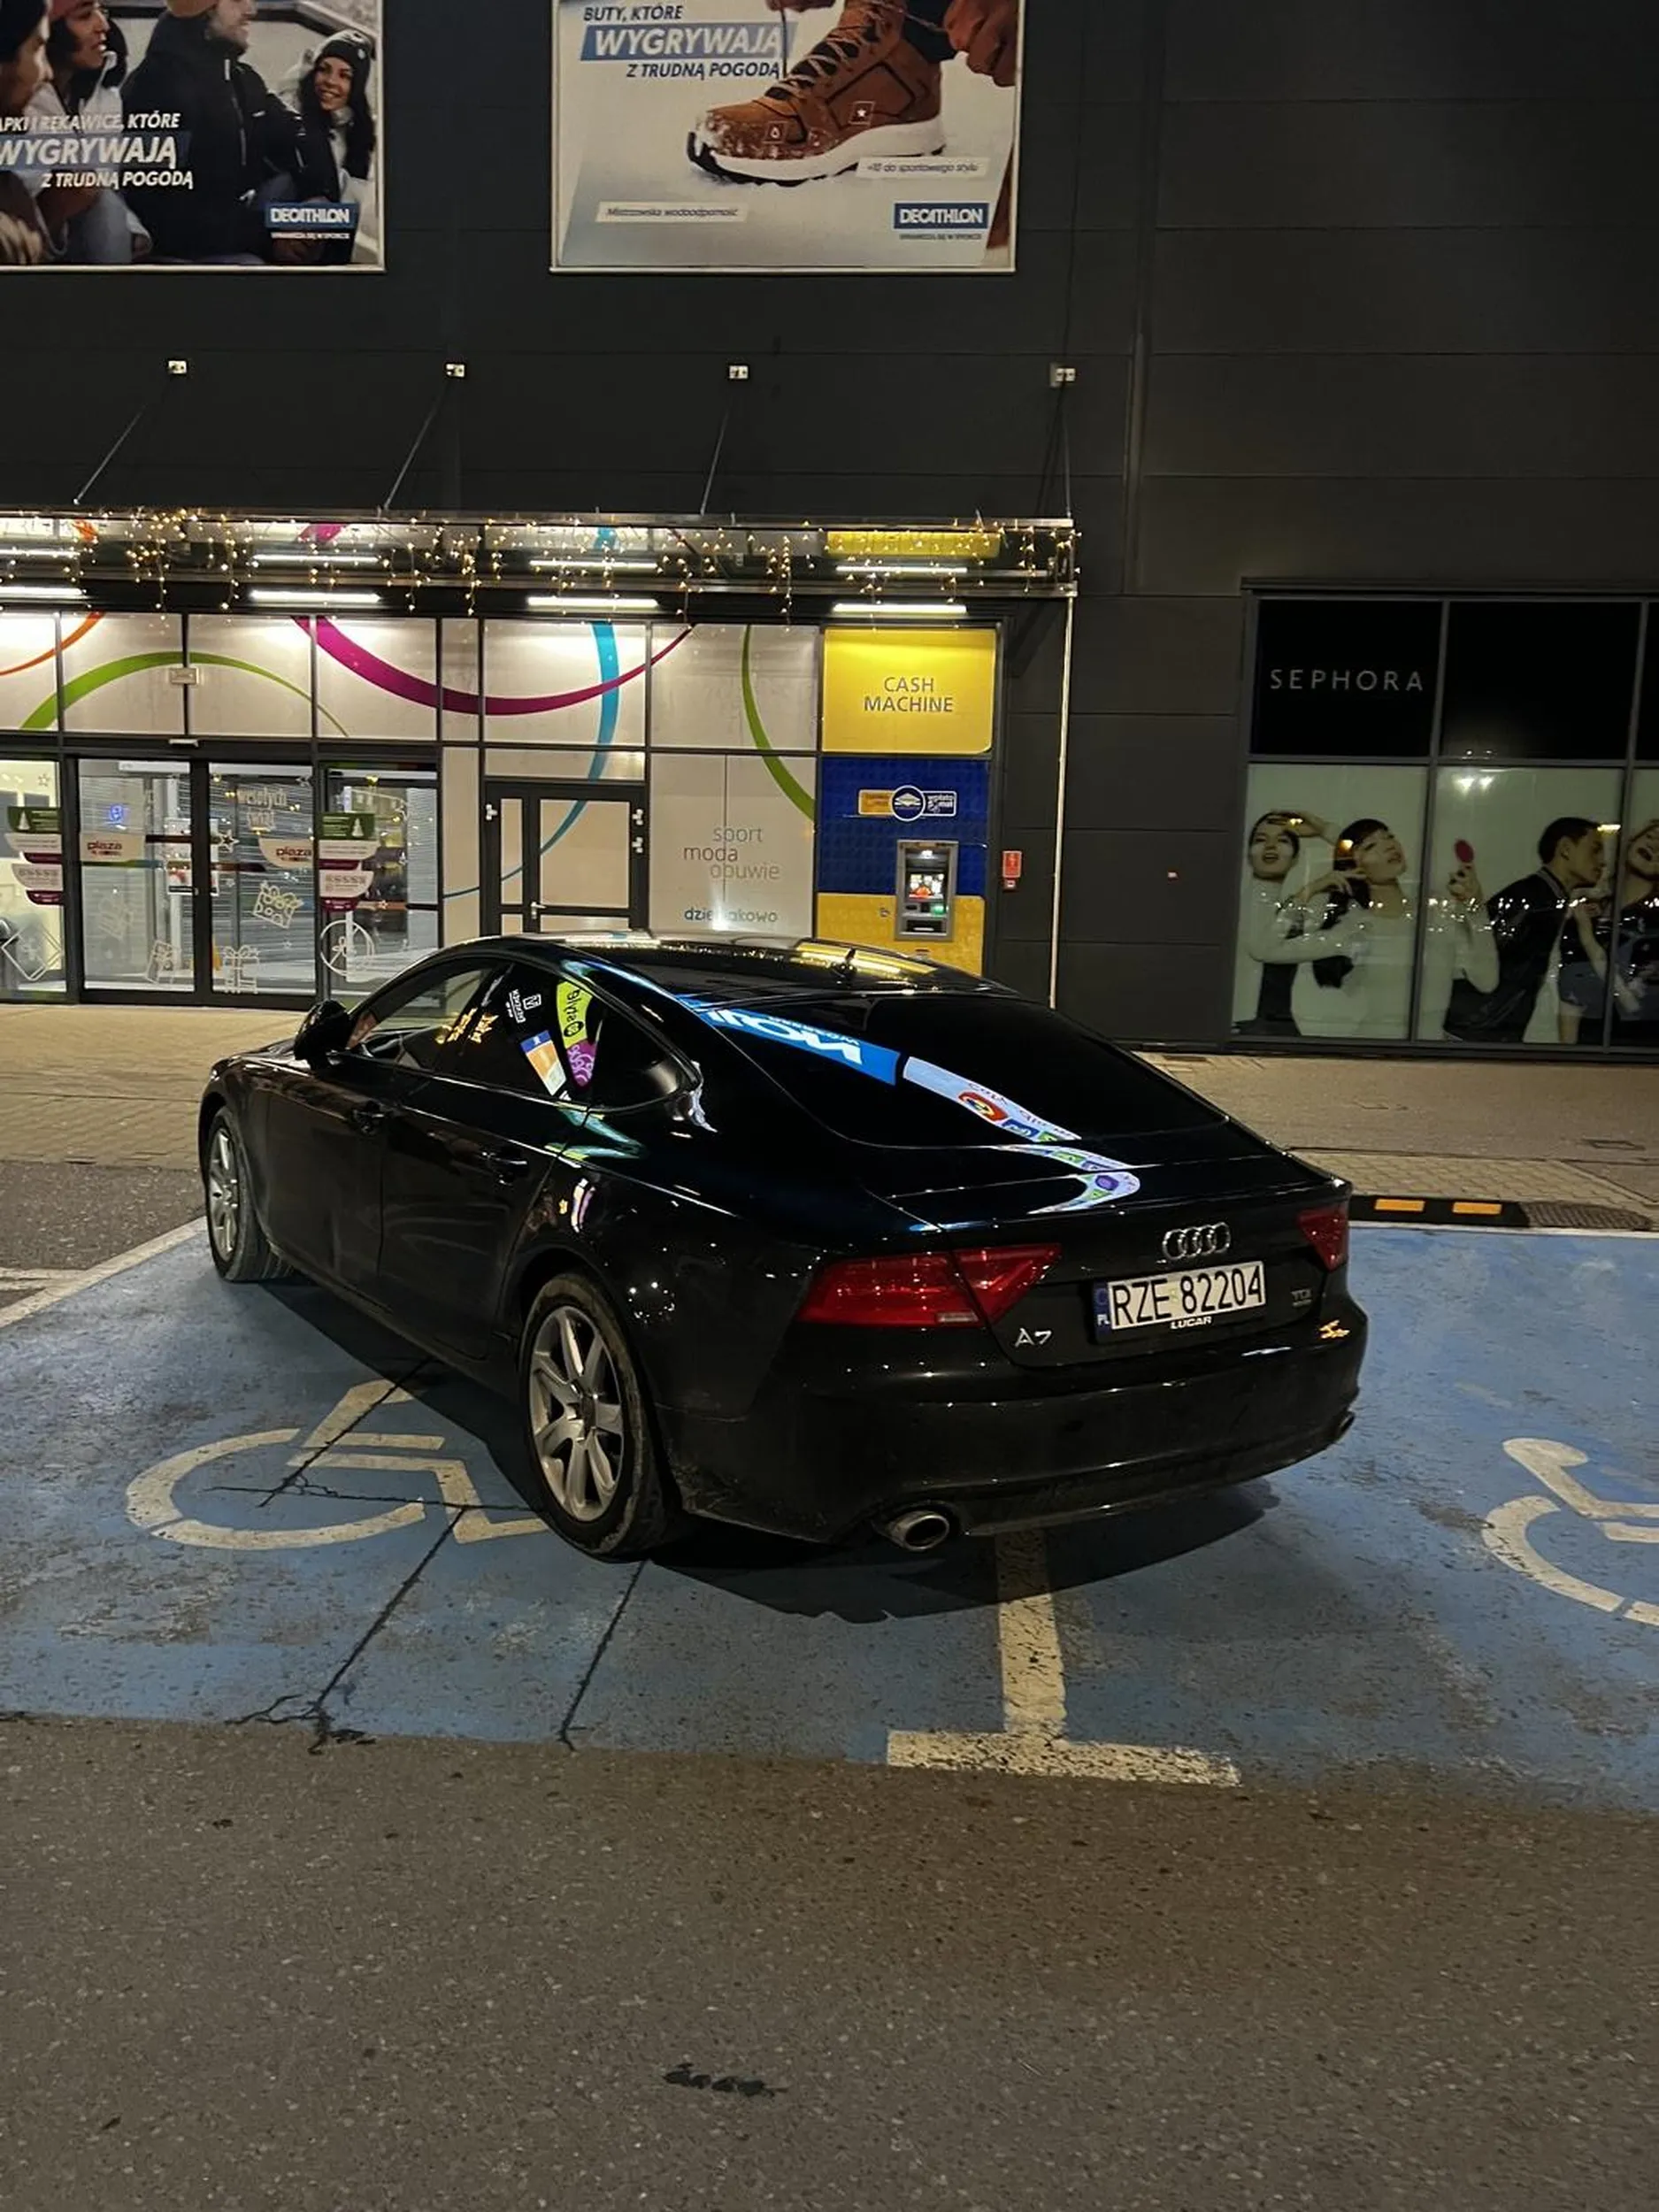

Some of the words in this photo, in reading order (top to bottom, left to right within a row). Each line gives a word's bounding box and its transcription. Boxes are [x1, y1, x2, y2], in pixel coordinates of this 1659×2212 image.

[583, 7, 627, 21] BUTY,
[630, 2, 683, 19] KTÓRE
[595, 27, 783, 58] WYGRYWAJĄ
[626, 64, 637, 78] Z
[641, 62, 705, 81] TRUDNĄ
[709, 61, 780, 80] POGODĄ
[127, 111, 181, 128] KTÓRE
[0, 136, 176, 170] WYGRYWAJĄ
[41, 173, 52, 188] Z
[55, 172, 119, 190] TRUDNĄ
[122, 171, 194, 190] POGODĄ
[271, 208, 349, 223] DECATHLON
[900, 208, 983, 224] DECATHLON
[884, 676, 934, 693] CASH
[1271, 669, 1423, 691] SEPHORA
[864, 695, 953, 712] MACHINE
[713, 826, 763, 843] sport
[276, 847, 311, 857] plaza
[683, 847, 738, 862] moda
[710, 862, 780, 880] obuwie
[684, 907, 778, 923] dzieakowo
[1112, 1278, 1172, 1326] RZE
[1180, 1265, 1263, 1314] 82204
[1171, 1316, 1212, 1329] LUCAR
[1015, 1327, 1052, 1348] A7
